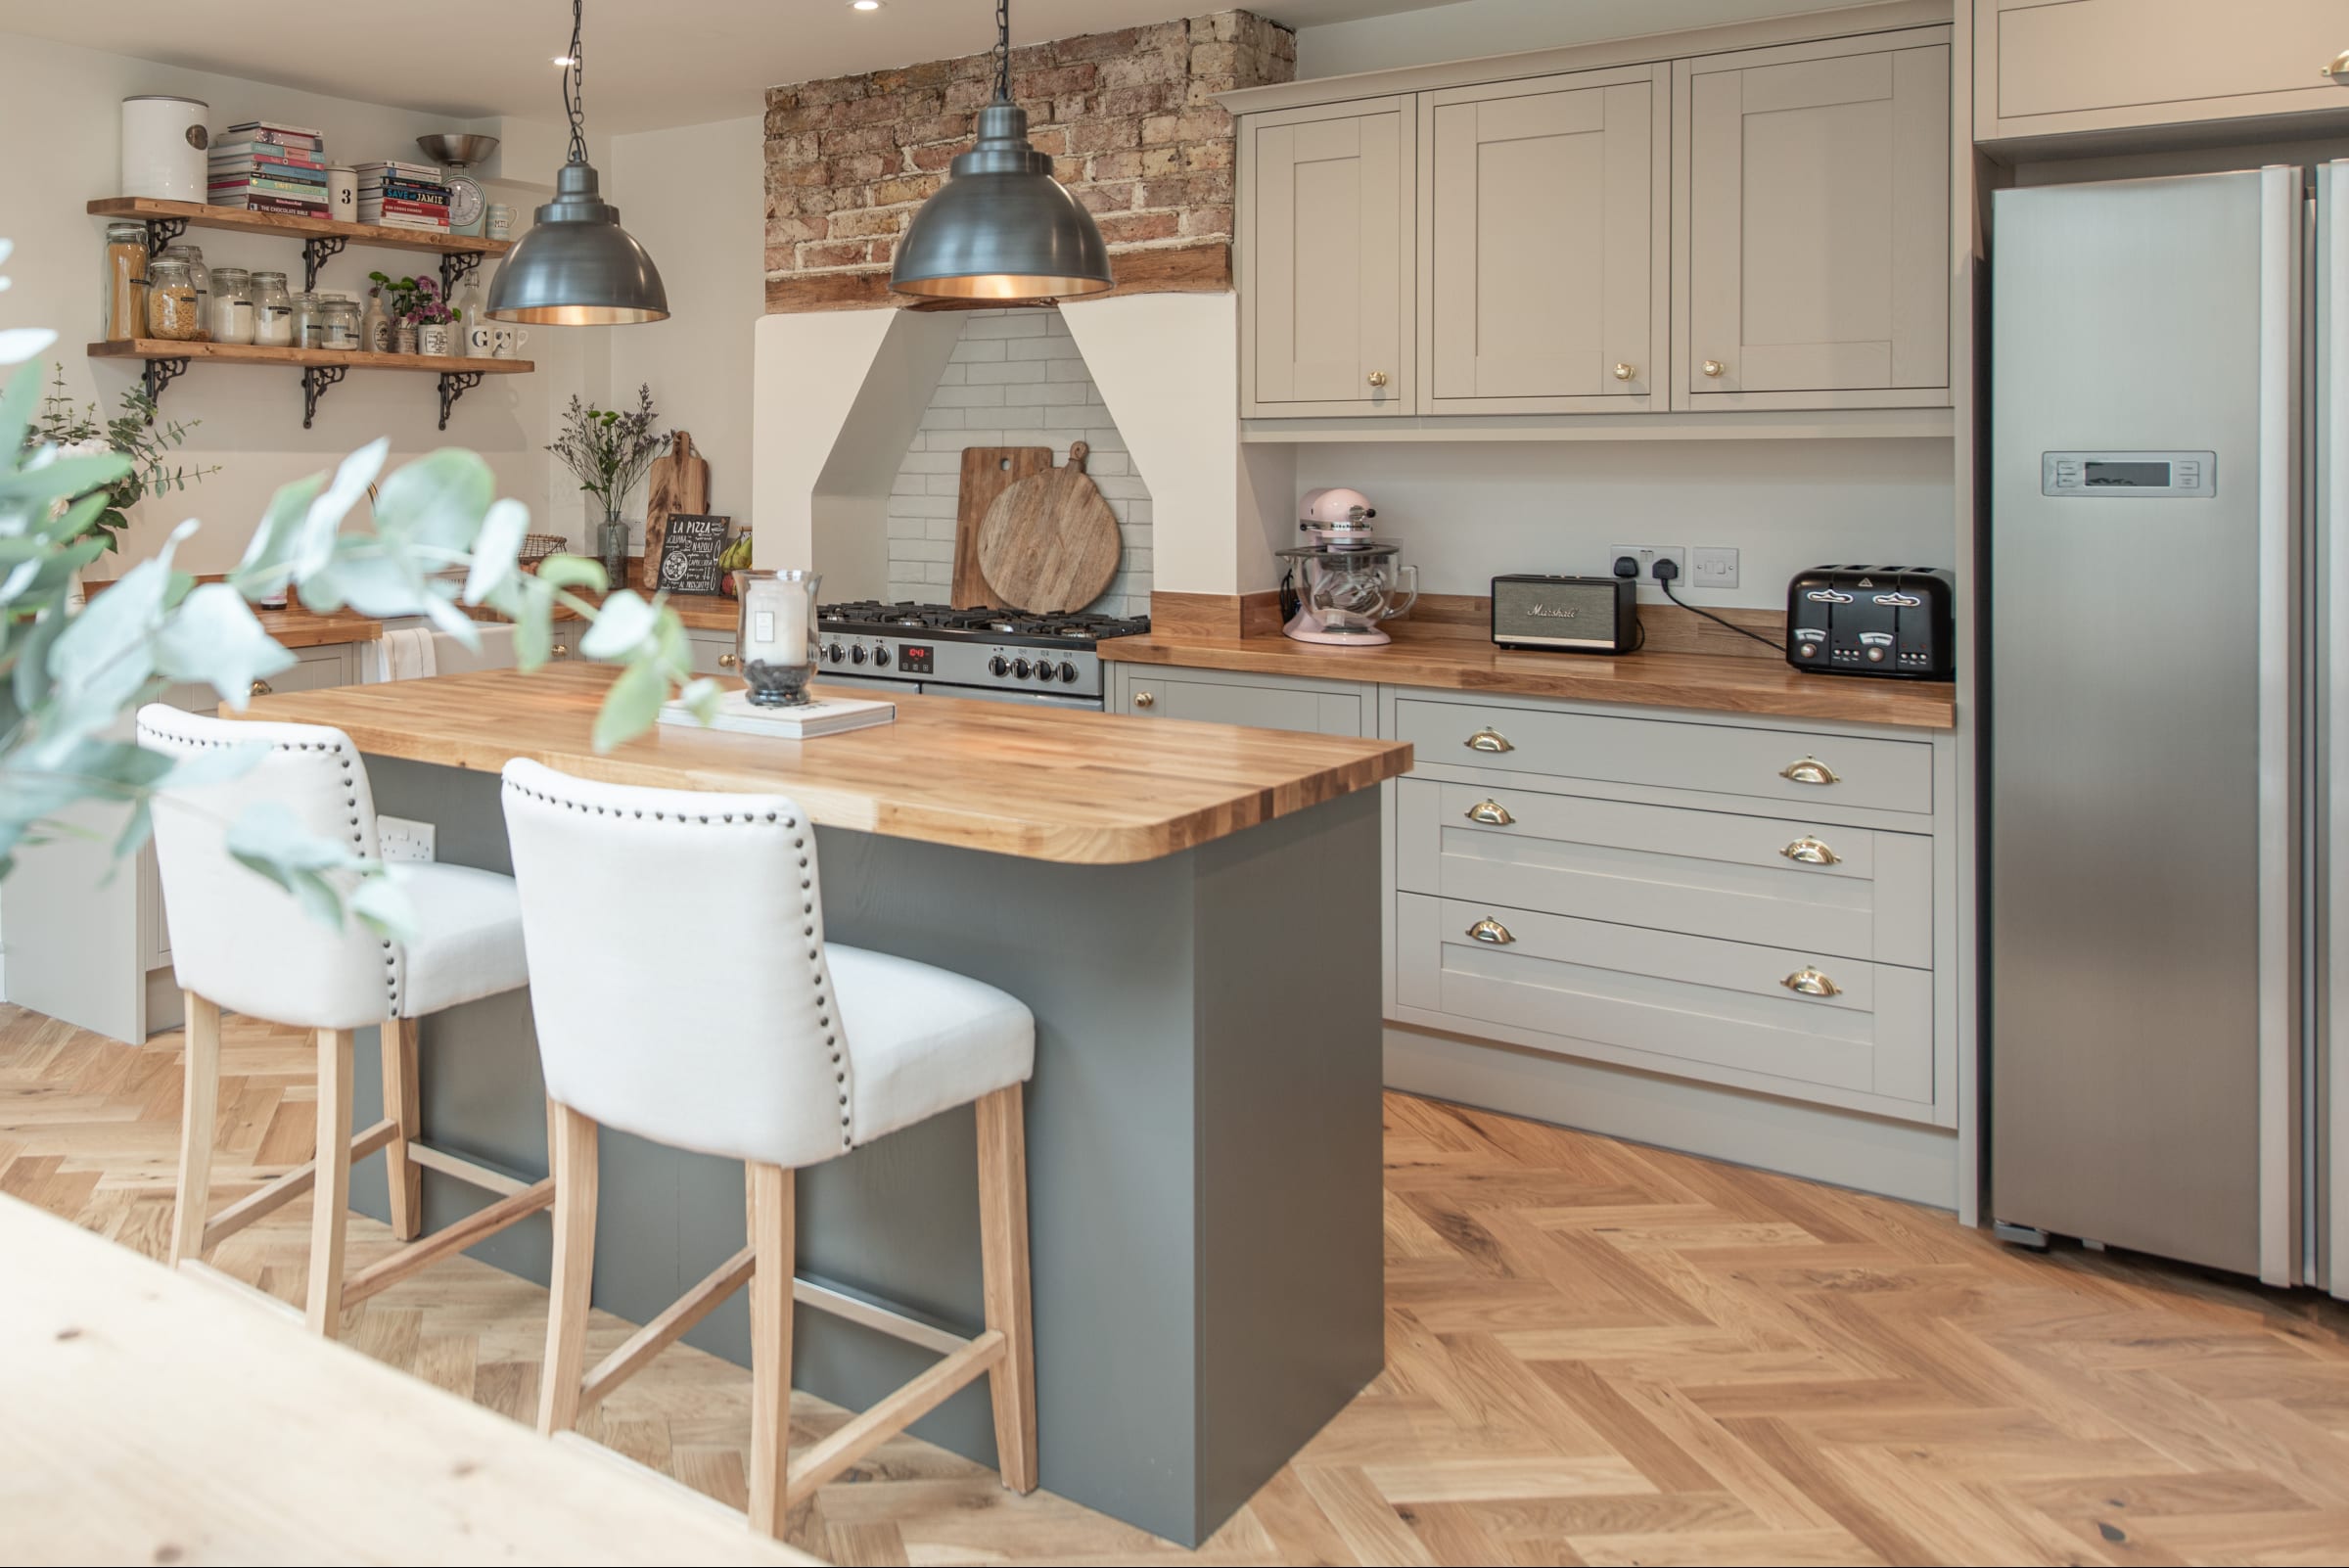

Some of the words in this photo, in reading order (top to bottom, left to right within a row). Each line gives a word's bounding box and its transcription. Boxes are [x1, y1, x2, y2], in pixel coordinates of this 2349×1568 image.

[342, 189, 351, 205] 3
[387, 188, 408, 200] SAVE
[416, 193, 443, 205] JAMIE
[270, 206, 296, 214] CHOCOLATE
[472, 331, 487, 347] G
[672, 521, 684, 533] LA
[686, 521, 711, 533] PIZZA
[1527, 603, 1576, 619] Marshall
